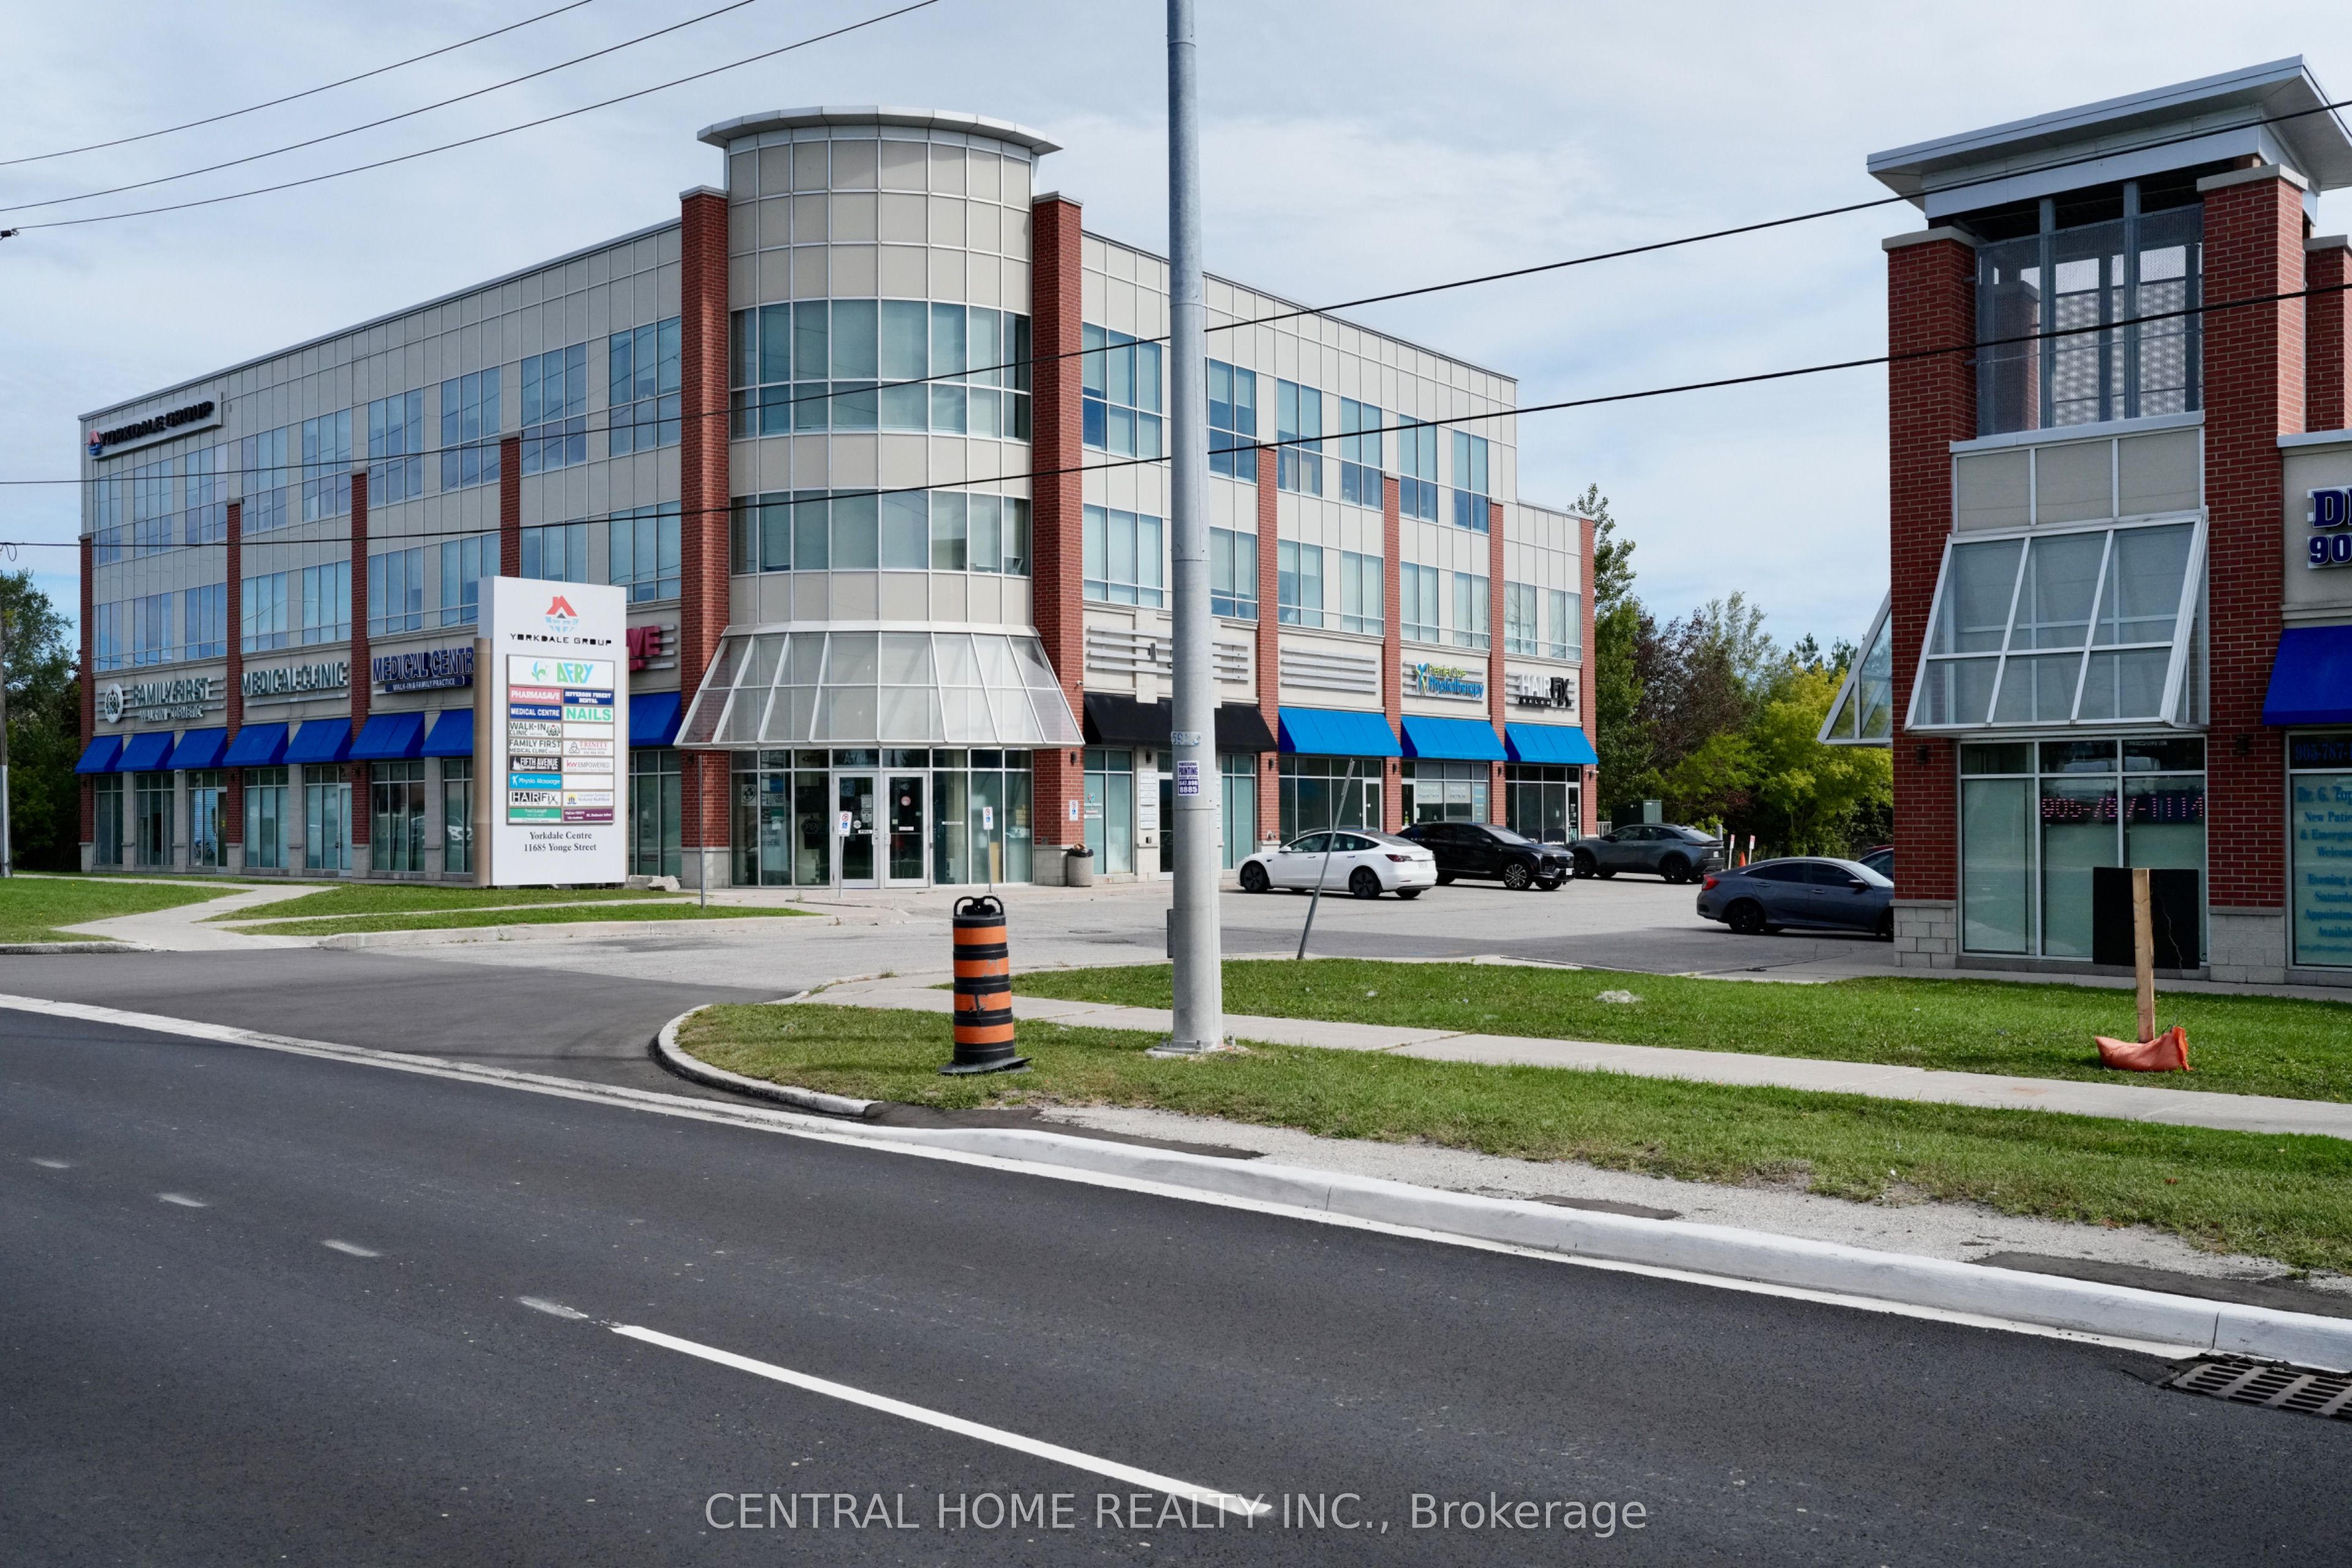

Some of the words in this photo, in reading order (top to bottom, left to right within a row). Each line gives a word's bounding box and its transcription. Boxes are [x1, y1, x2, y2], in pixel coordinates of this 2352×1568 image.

[100, 416, 166, 446] YORKDALE
[166, 401, 214, 427] GROUP
[2312, 488, 2352, 527] D
[510, 633, 569, 644] YORKDALE
[574, 638, 612, 646] GROUP
[373, 652, 429, 682] MEDICAL
[431, 647, 473, 677] CENTR
[241, 667, 297, 696] MEDICAL
[301, 662, 349, 690] CLINIC
[416, 680, 432, 689] FAMILY
[432, 677, 455, 687] PRACTICE
[133, 681, 172, 706] FAMILY
[175, 677, 209, 703] FIRST
[1428, 676, 1483, 698] Physiotherapy
[511, 690, 560, 700] PHARMASAVE
[510, 707, 537, 716] MEDICAL
[566, 707, 611, 721] NAILS
[510, 722, 546, 731] WALK-IN
[510, 739, 537, 747] FAMILY
[520, 757, 536, 766] FIFTH
[537, 758, 559, 767] AVENUE
[2304, 812, 2324, 823] New
[530, 831, 564, 840] Yorkdale
[524, 843, 546, 852] 11685
[548, 843, 571, 853] Yonge
[2307, 873, 2346, 886] Evening
